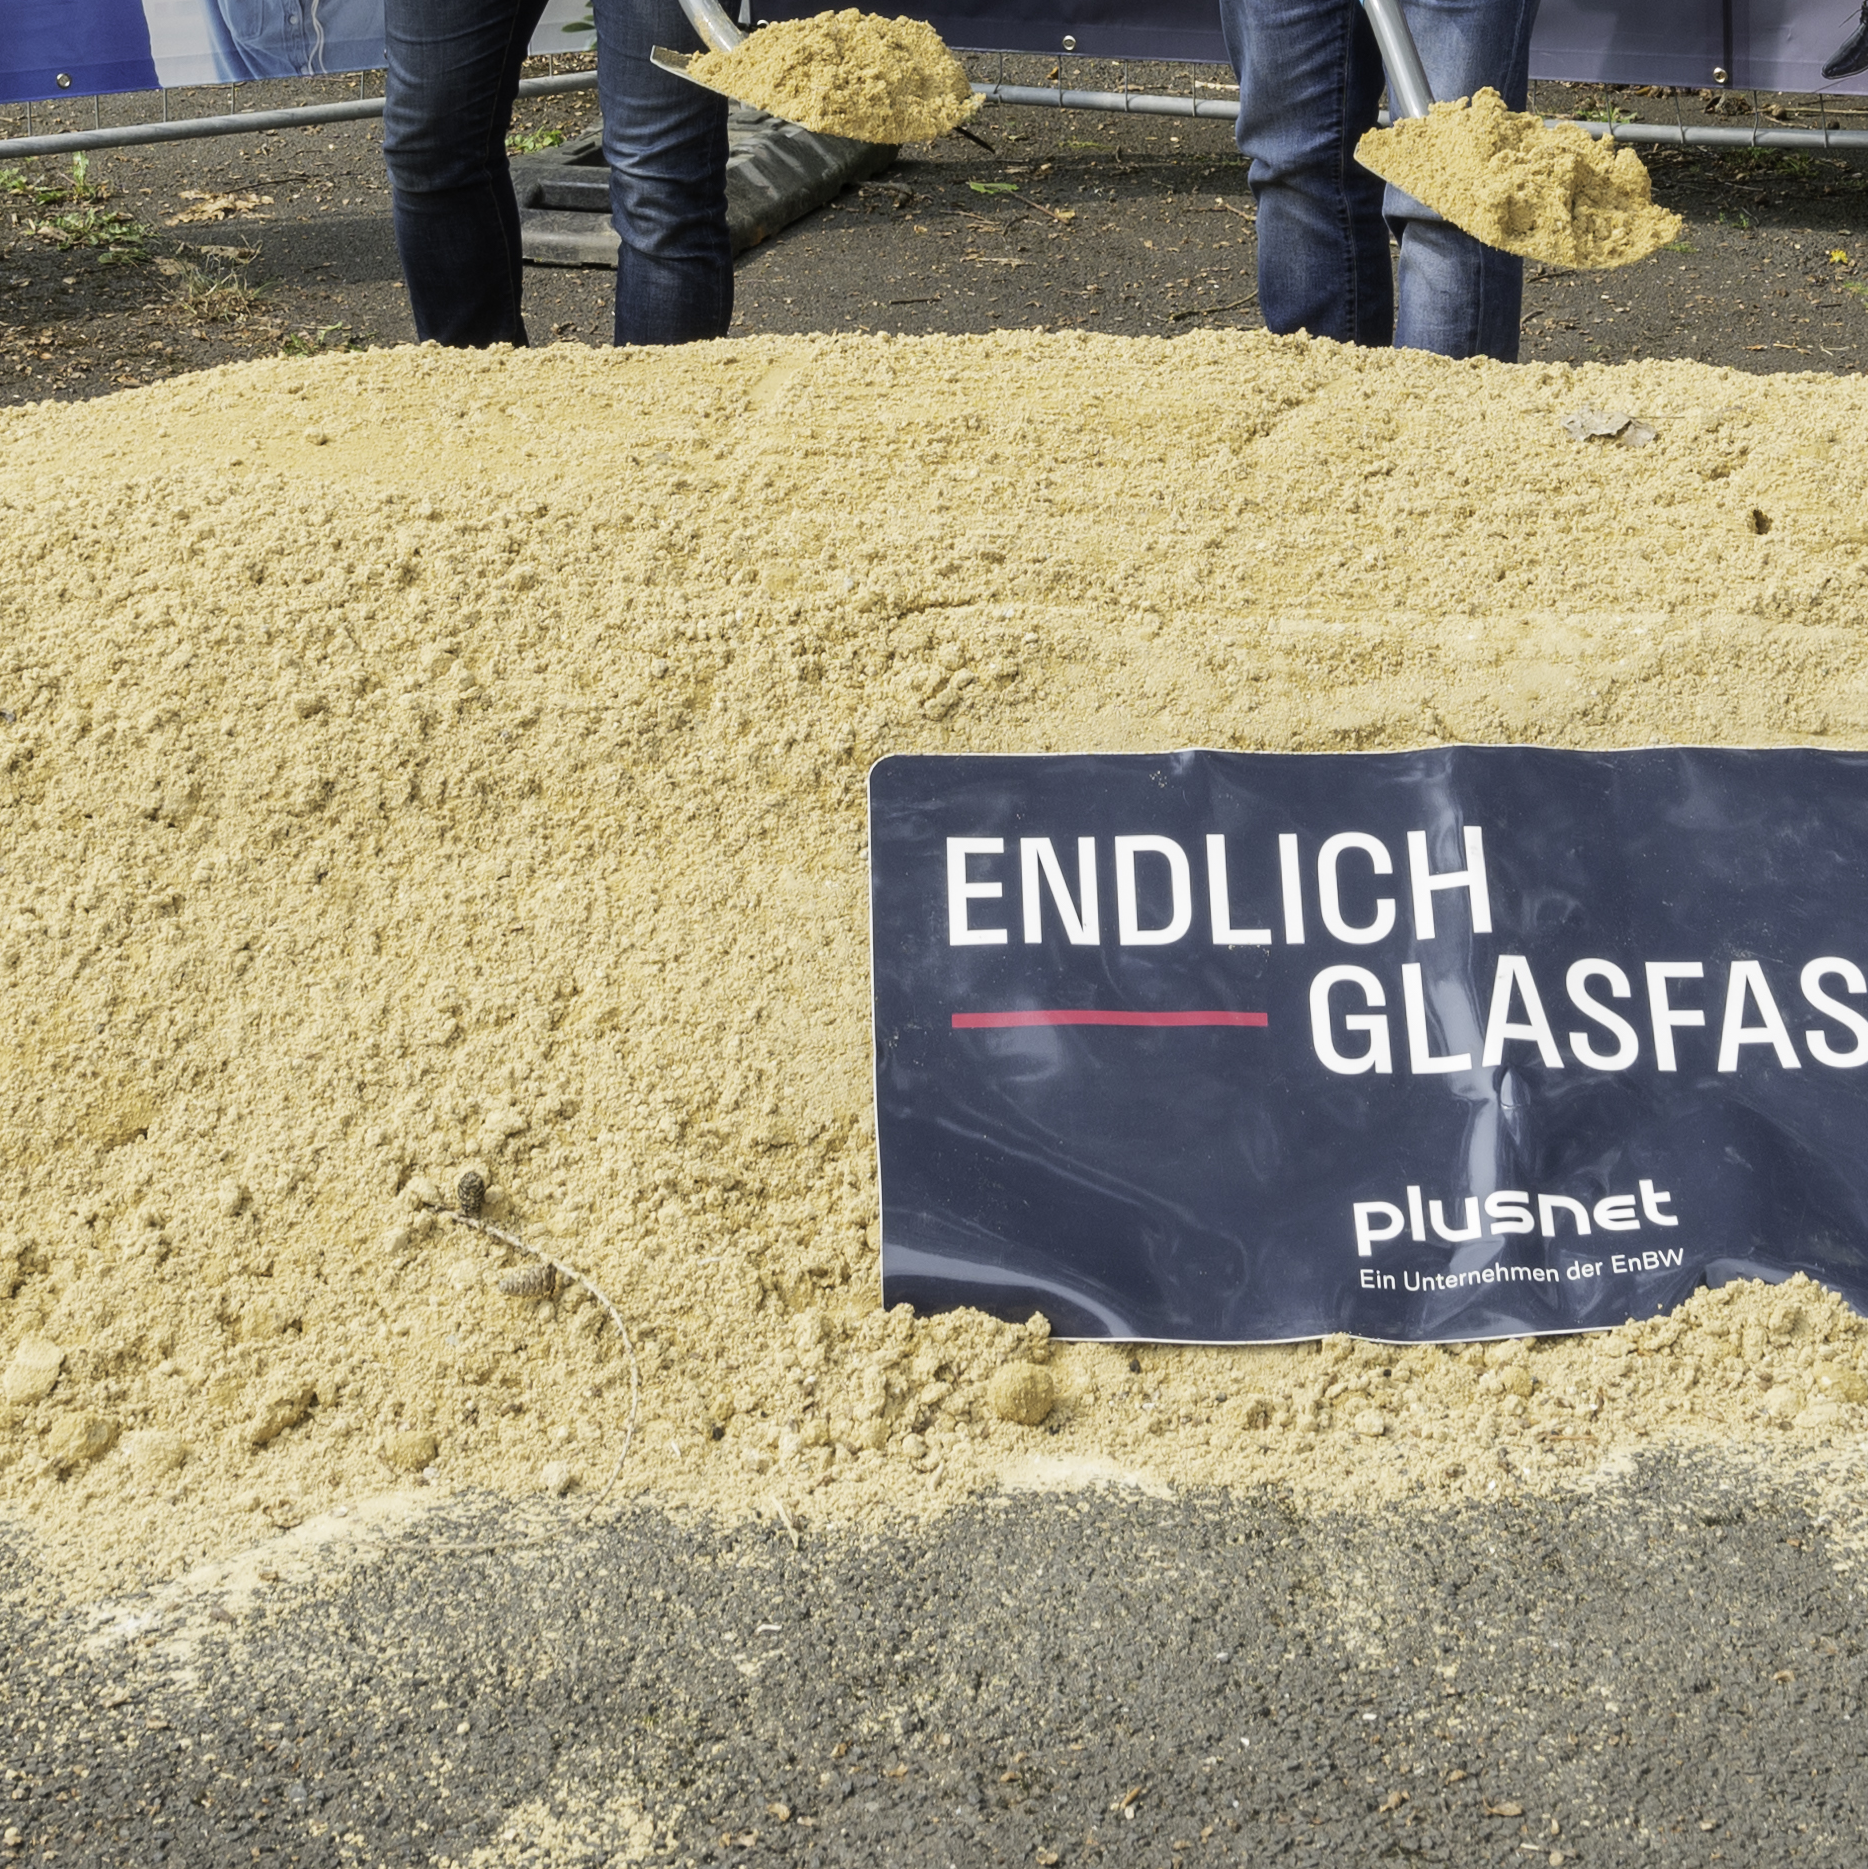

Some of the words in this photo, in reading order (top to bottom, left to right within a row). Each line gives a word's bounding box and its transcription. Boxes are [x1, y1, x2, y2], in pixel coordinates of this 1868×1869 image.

[944, 825, 1494, 948] ENDLICH
[1353, 1179, 1679, 1257] plusnet
[1360, 1269, 1396, 1290] Ein
[1403, 1262, 1560, 1292] Unternehmen
[1567, 1259, 1604, 1281] der
[1611, 1248, 1685, 1275] EnBW
